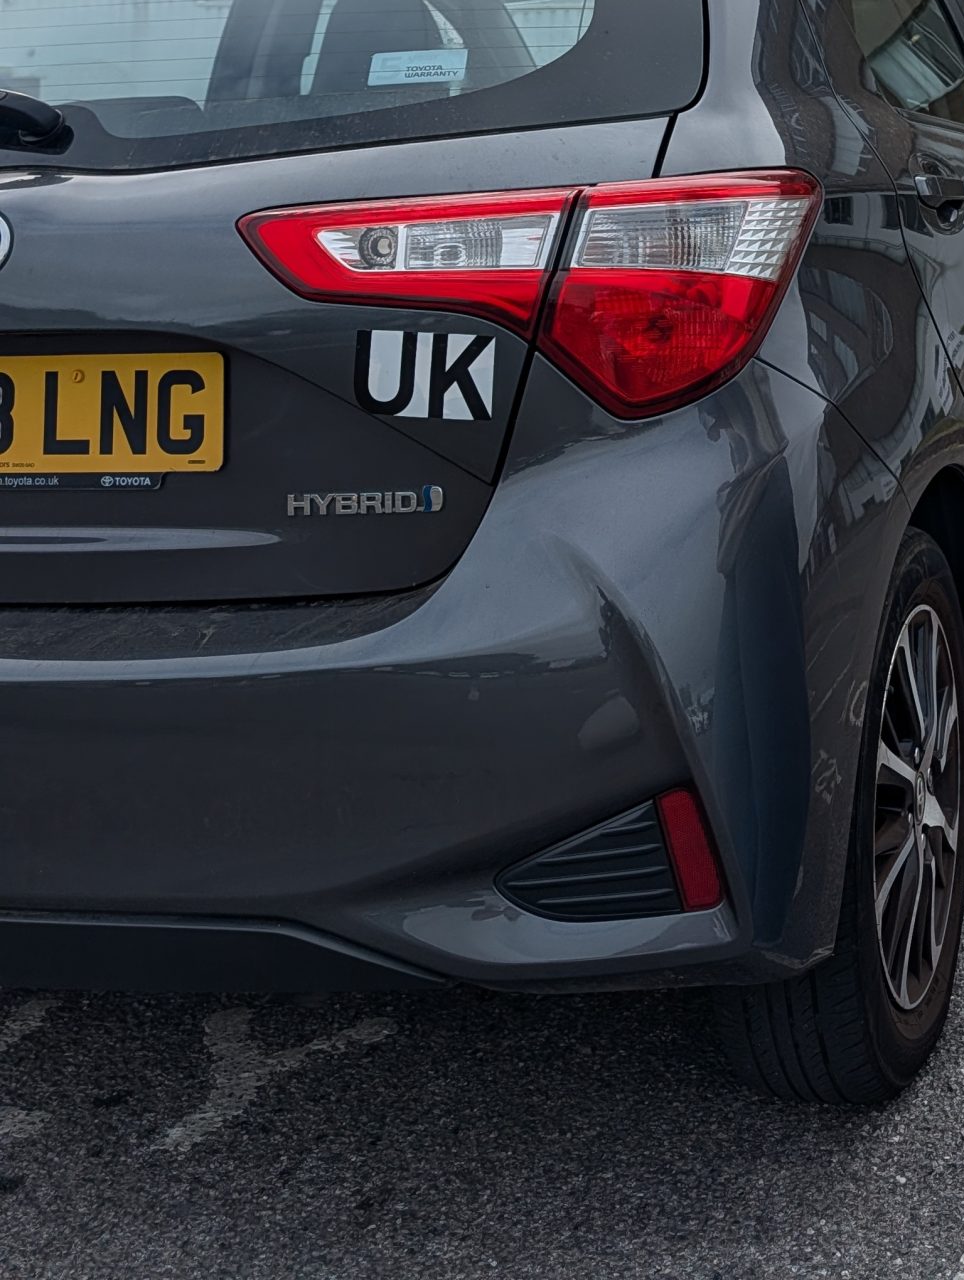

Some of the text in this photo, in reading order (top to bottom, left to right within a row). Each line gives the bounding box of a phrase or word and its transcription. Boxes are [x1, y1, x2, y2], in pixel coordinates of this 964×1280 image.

[404, 70, 459, 79] WARRANTY
[405, 64, 443, 72] TOYOTA
[354, 329, 496, 420] UK
[43, 370, 206, 455] LNG
[115, 477, 151, 487] TOYOTA
[287, 491, 418, 516] HYBRID
